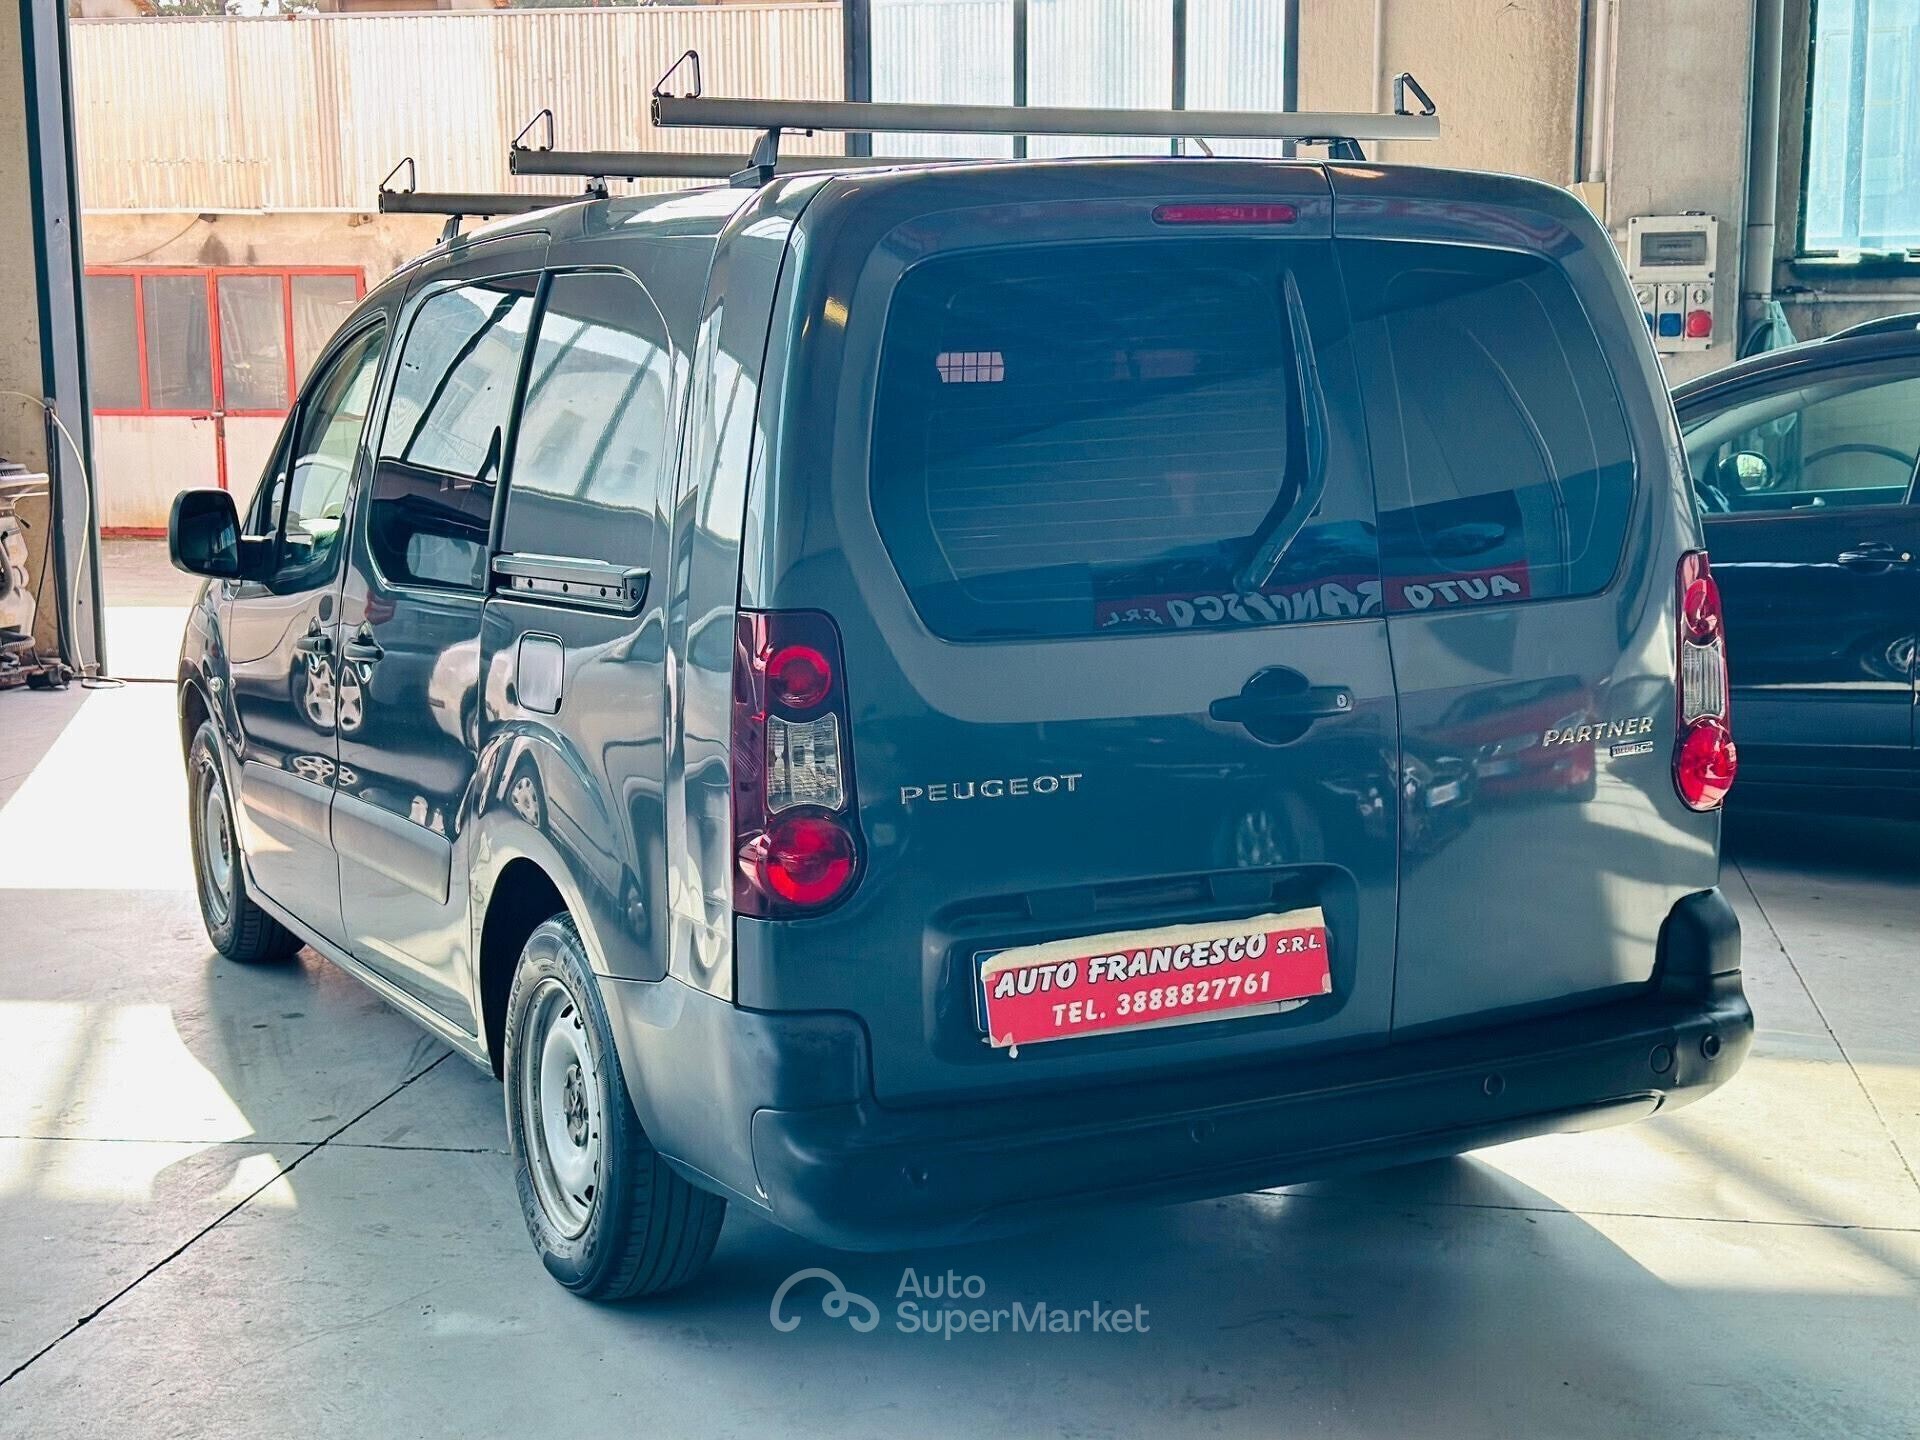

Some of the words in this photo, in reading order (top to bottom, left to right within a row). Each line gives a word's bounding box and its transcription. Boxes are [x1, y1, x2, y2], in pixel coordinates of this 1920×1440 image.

[1542, 716, 1653, 747] PARTNER
[901, 773, 1082, 805] PEUGEOT
[994, 962, 1078, 999] AUTO
[1088, 933, 1267, 984] FRANCESCO
[1276, 934, 1322, 955] S.R.L.
[1052, 1003, 1106, 1026] TEL.
[1116, 971, 1271, 1016] 3888827761
